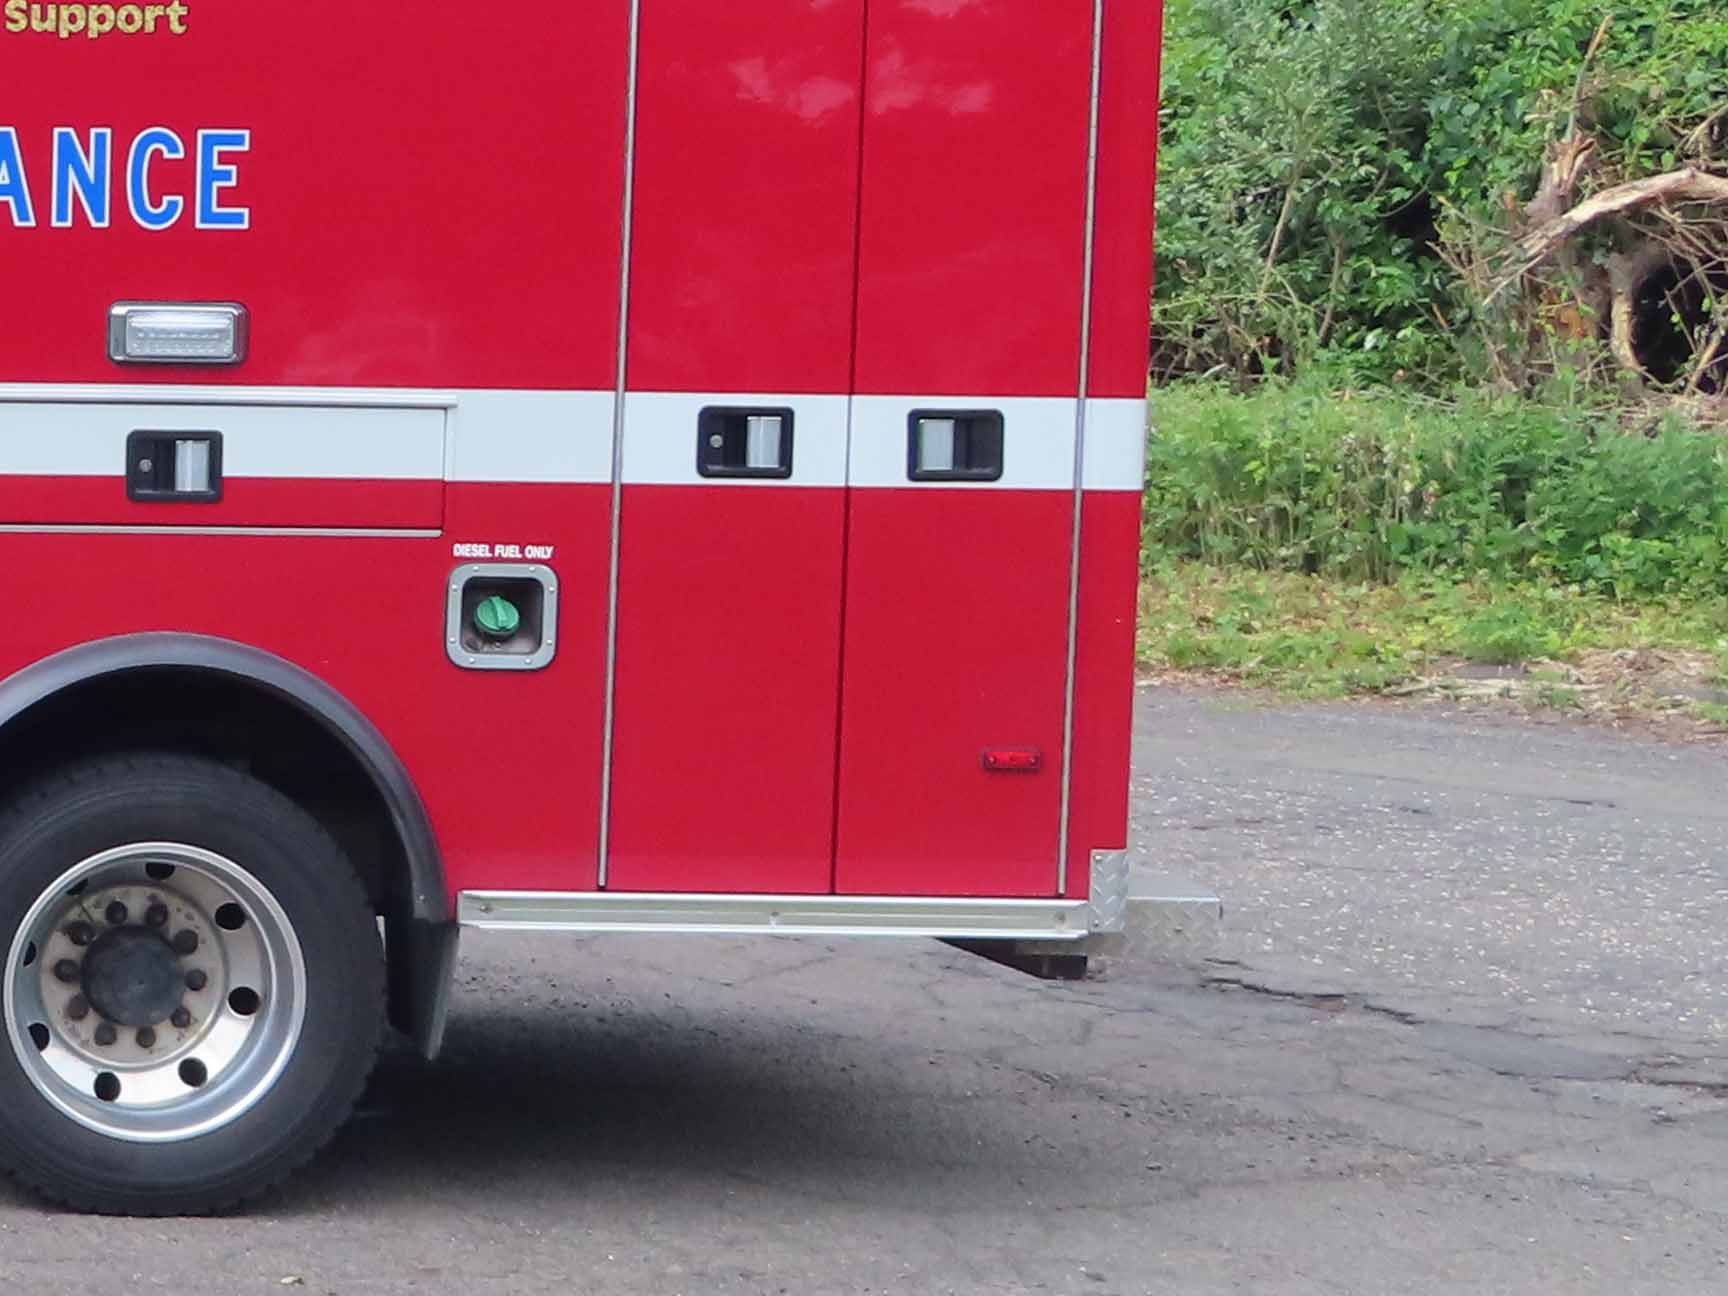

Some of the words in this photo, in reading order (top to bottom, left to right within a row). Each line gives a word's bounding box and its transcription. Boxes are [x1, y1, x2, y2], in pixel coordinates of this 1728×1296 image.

[453, 543, 492, 558] DIESEL
[494, 544, 523, 558] FUEL
[524, 545, 554, 559] ONLY
